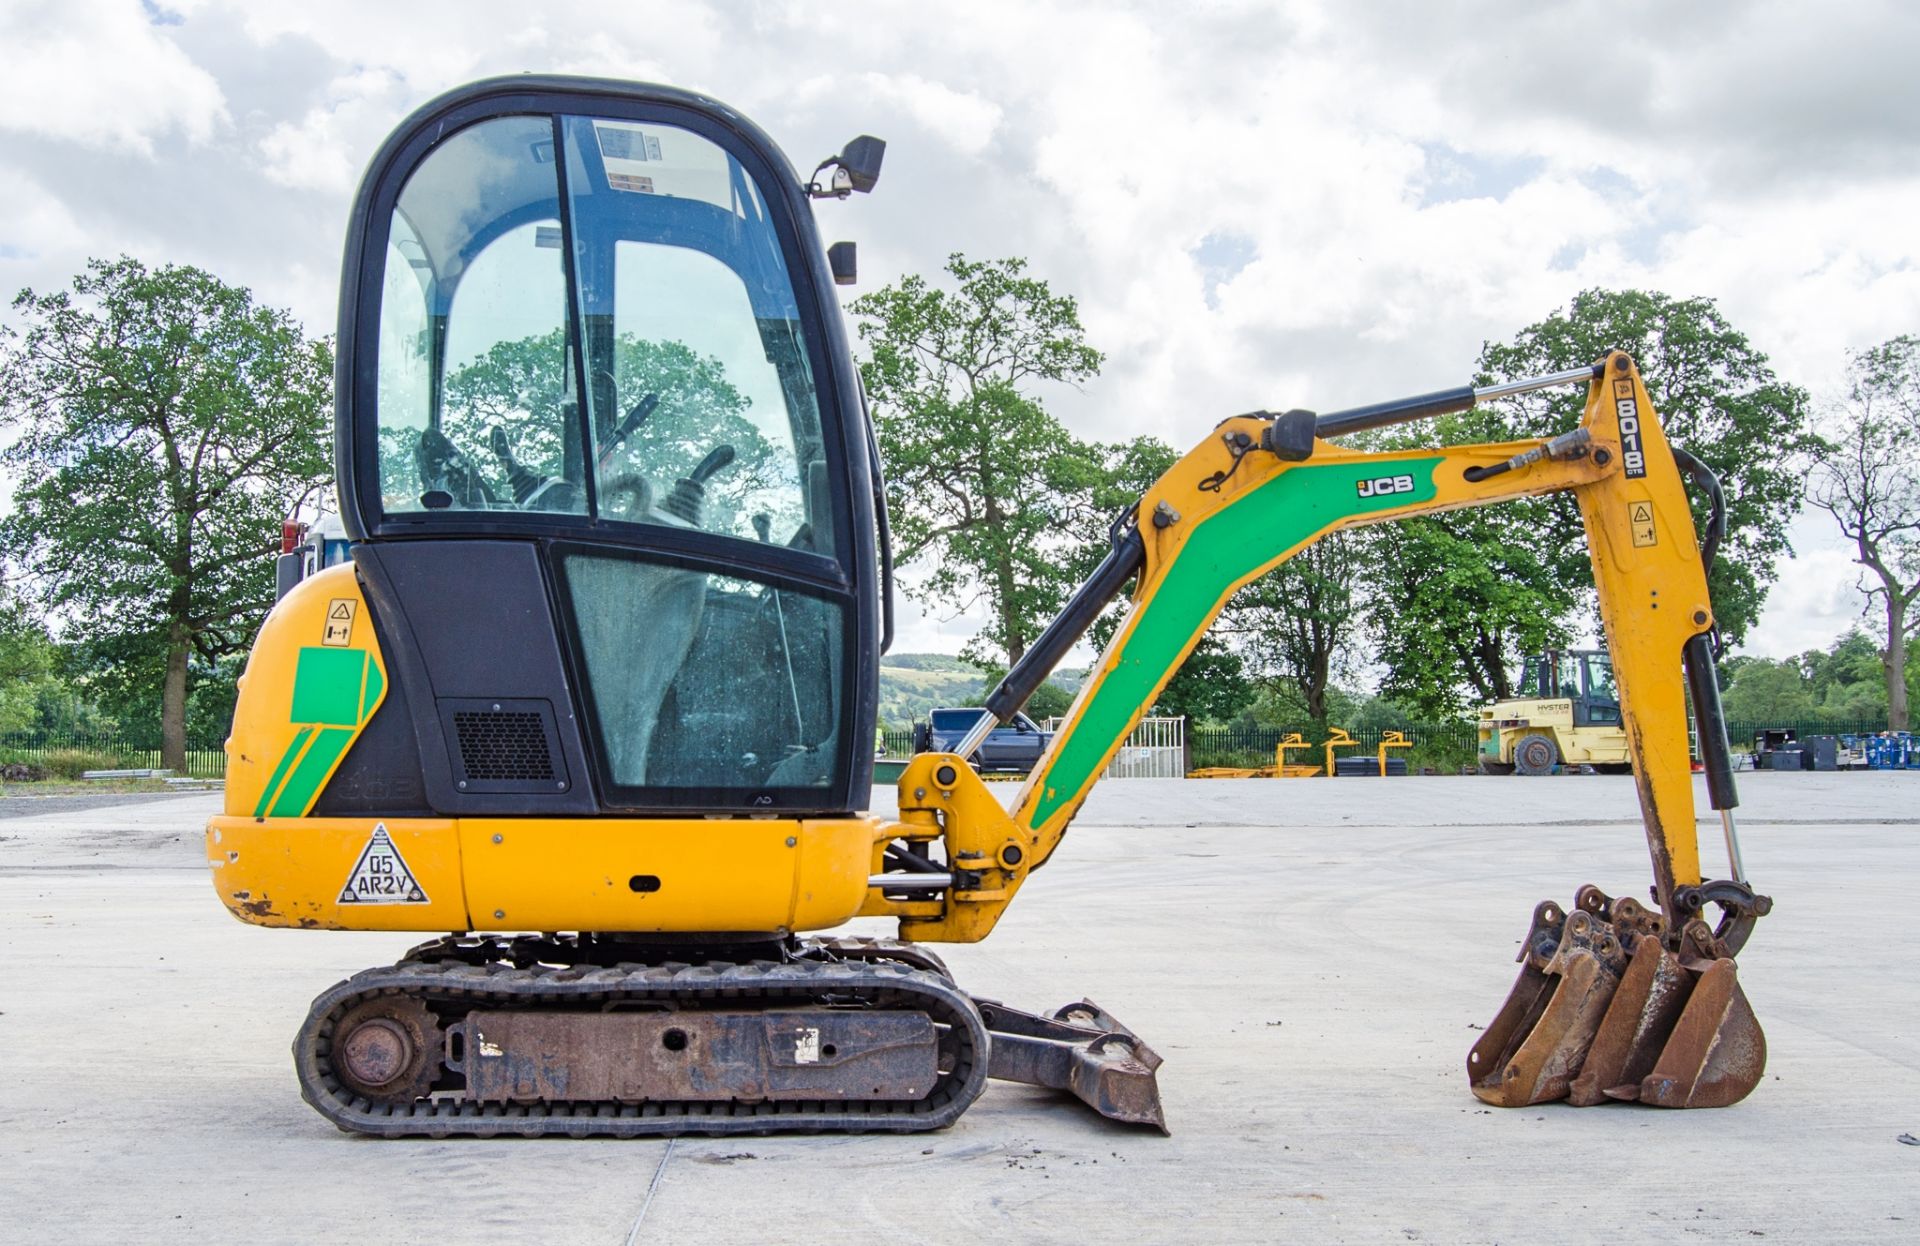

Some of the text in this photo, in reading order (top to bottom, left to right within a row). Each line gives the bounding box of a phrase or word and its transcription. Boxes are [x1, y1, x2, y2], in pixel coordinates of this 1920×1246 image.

[1617, 400, 1643, 469] 8018
[1357, 475, 1414, 497] JCB
[1537, 703, 1570, 711] HYSTER
[358, 875, 407, 895] AR2Y
